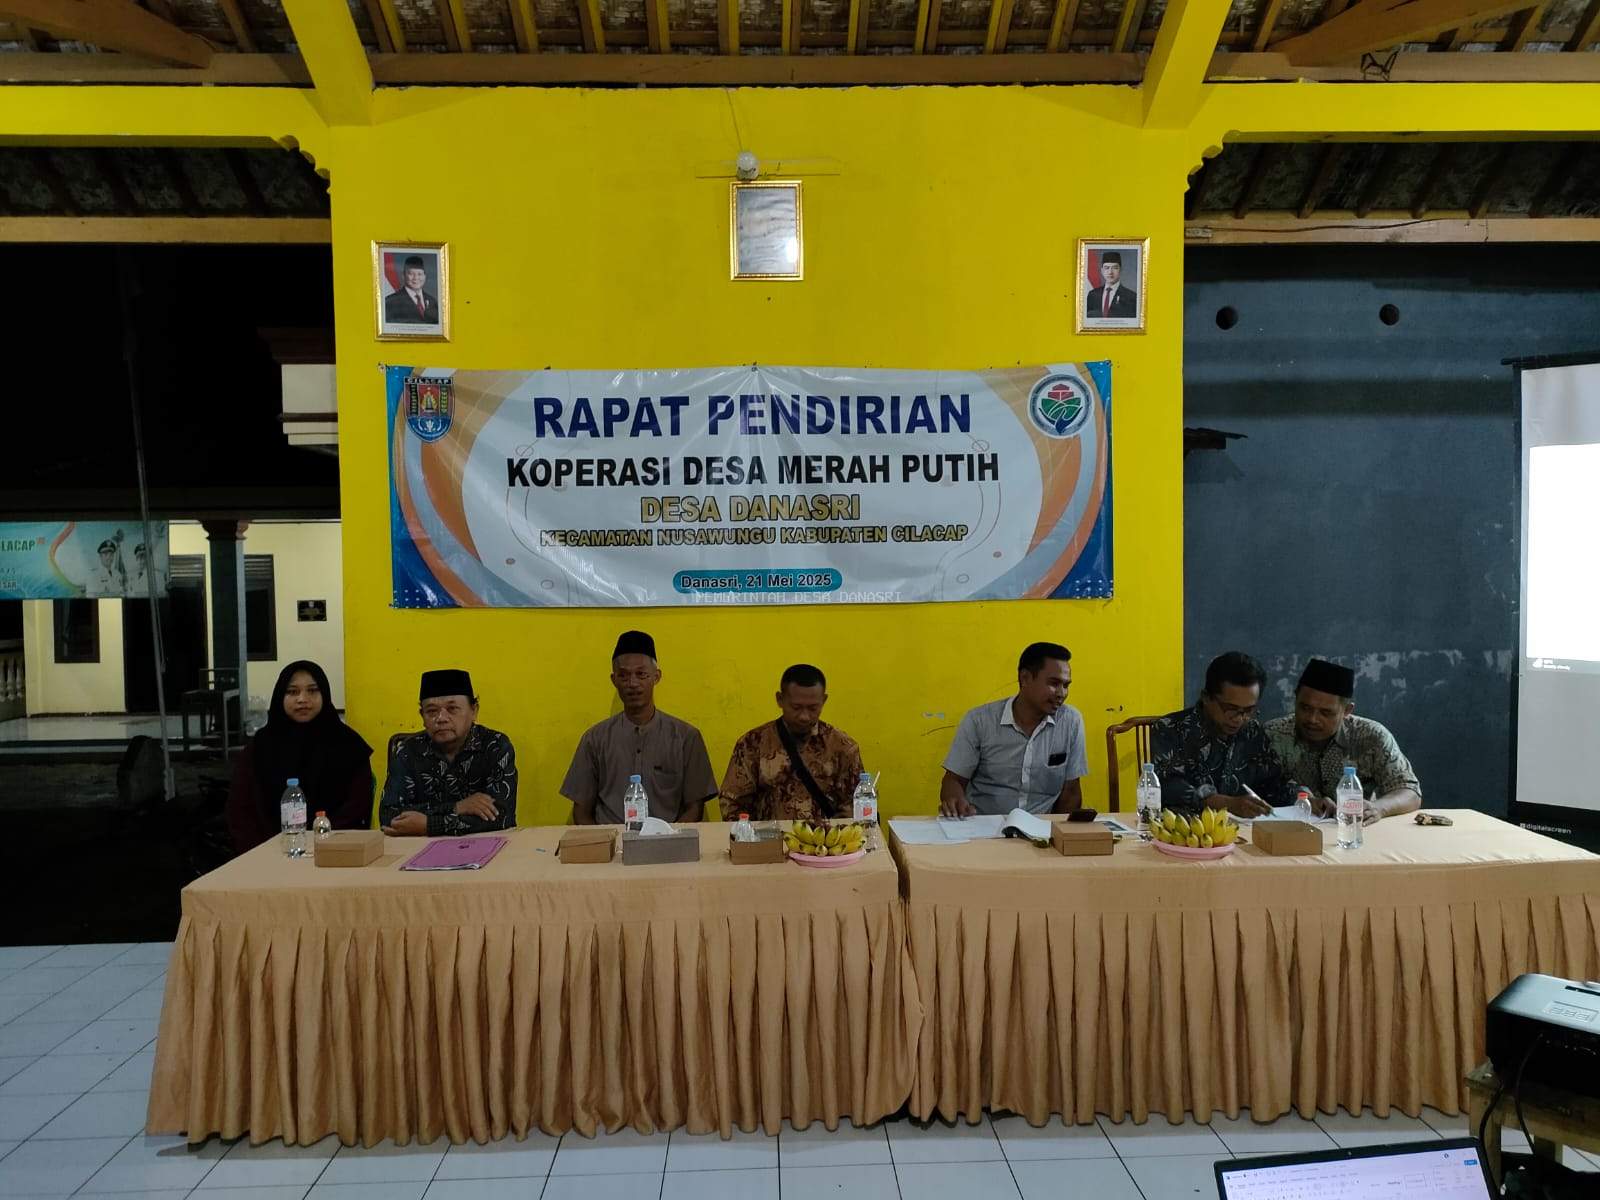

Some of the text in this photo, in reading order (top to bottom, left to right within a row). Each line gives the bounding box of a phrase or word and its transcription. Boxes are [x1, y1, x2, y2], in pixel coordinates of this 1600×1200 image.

[534, 394, 970, 438] RAPAT PENDIRIAN
[507, 453, 999, 488] KOPERASI DESA MERAH PUTIH
[640, 494, 860, 523] DESA DANASRI
[540, 525, 968, 547] KECAMATAN NUSAWUNGU KABUPATEN CILACAP
[680, 573, 833, 589] Danasri, 21 Mei 2025
